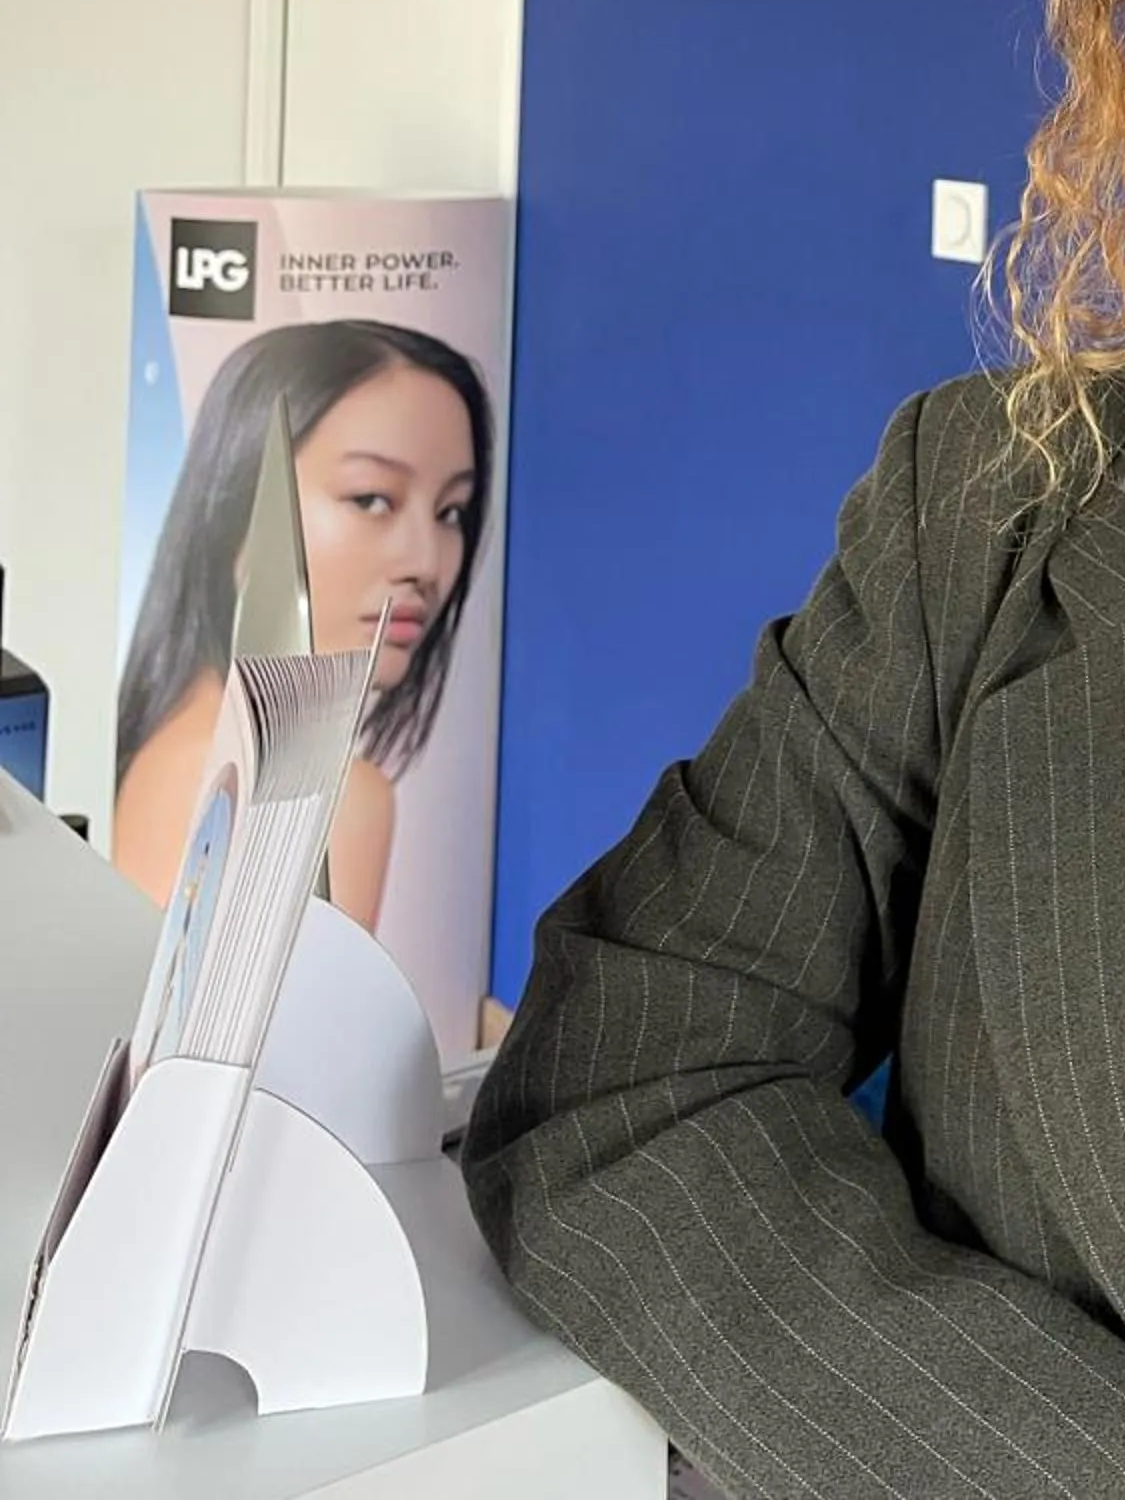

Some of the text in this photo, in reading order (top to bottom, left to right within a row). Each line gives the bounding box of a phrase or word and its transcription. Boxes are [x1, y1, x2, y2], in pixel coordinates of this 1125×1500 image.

[176, 246, 250, 292] LPG
[280, 250, 459, 271] INNER POWER.
[280, 272, 439, 293] BETTER LIFE.
